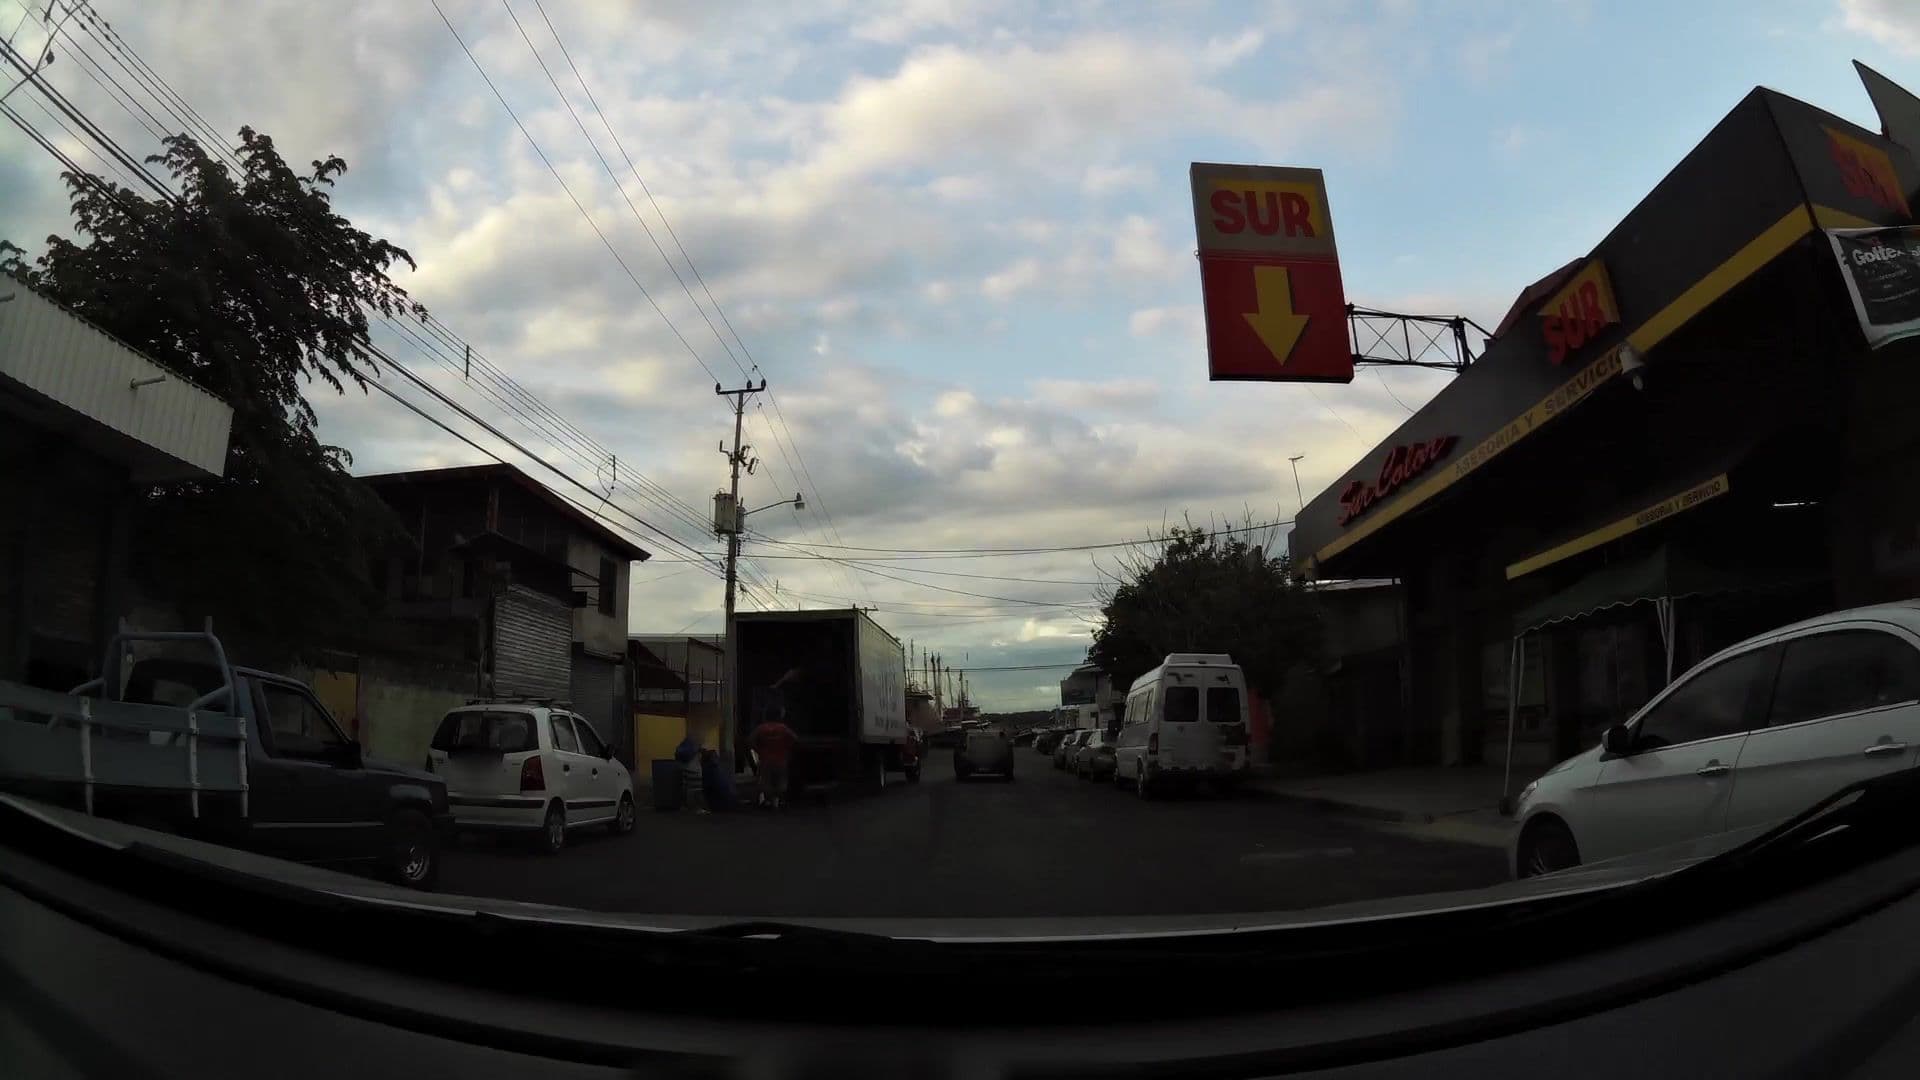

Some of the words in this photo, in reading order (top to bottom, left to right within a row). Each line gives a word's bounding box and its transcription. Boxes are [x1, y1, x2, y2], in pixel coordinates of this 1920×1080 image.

[1210, 189, 1316, 238] SUR
[1543, 281, 1605, 365] SUR
[1524, 412, 1535, 429] Y
